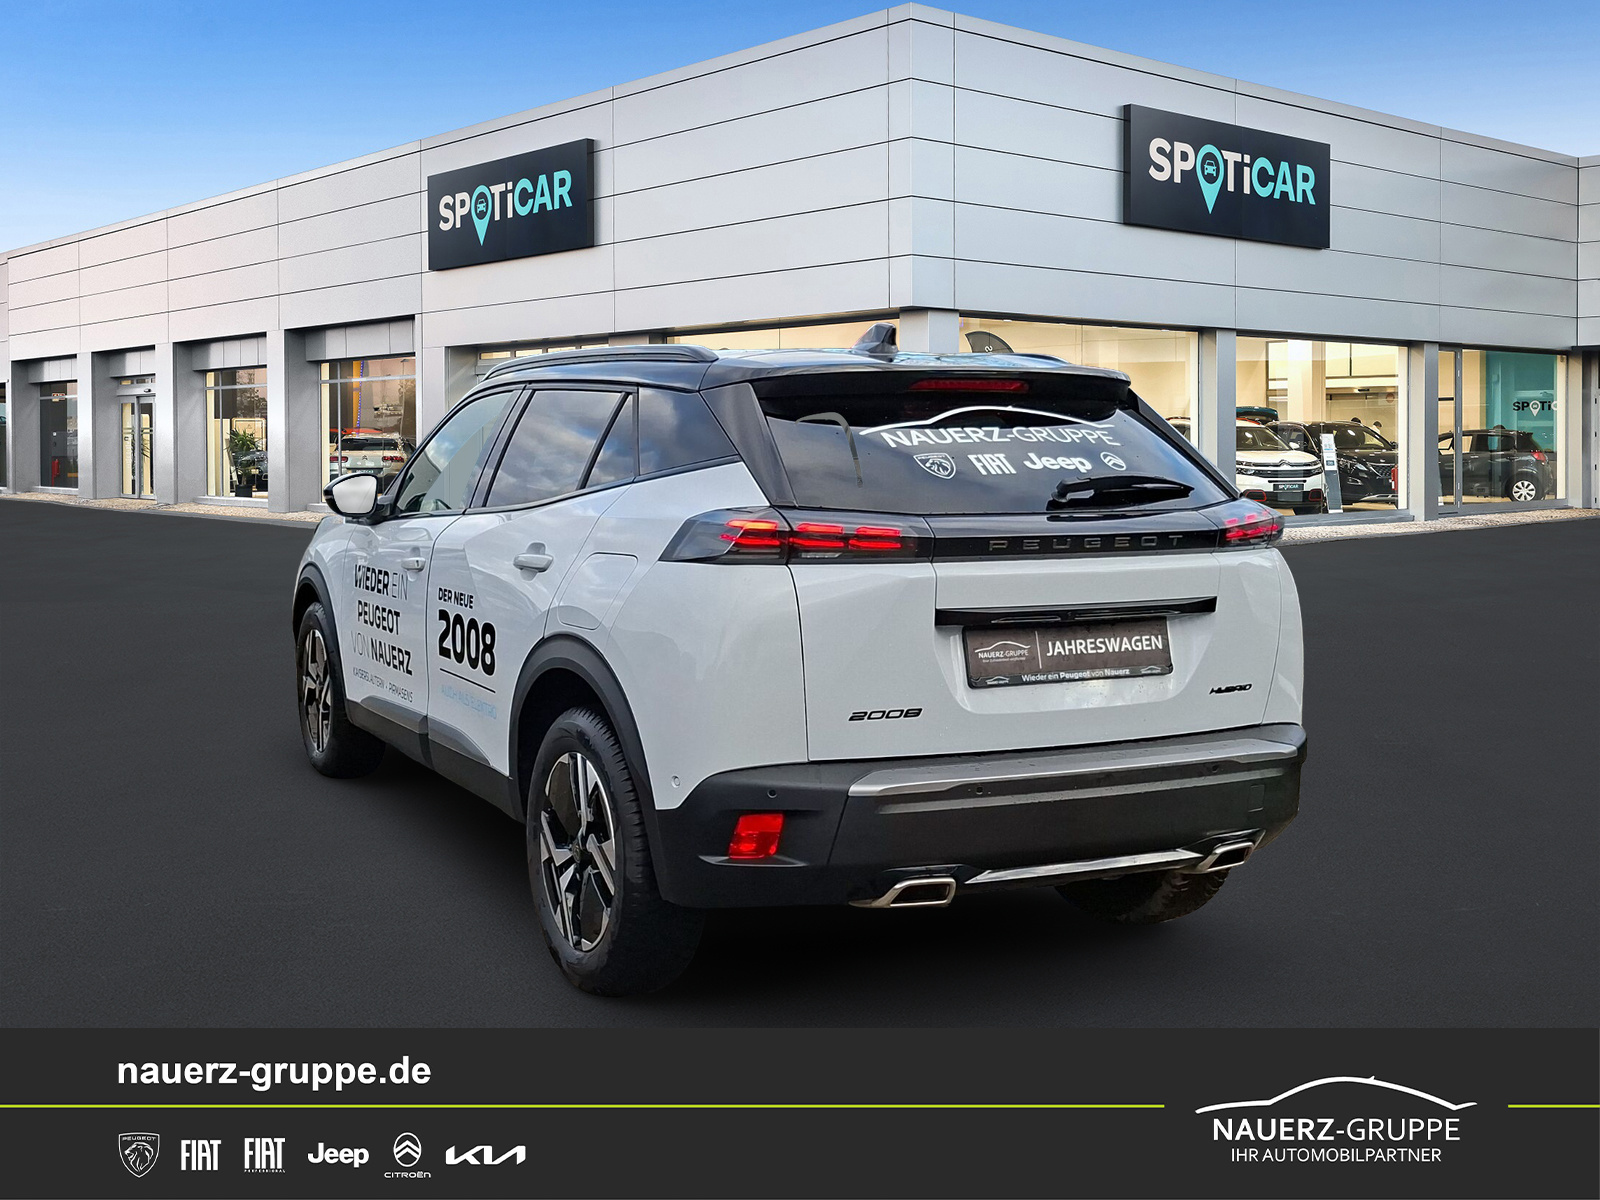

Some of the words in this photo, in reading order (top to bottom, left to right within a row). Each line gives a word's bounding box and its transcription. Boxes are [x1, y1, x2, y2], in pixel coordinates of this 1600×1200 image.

[880, 426, 1122, 448] NAUERZ-GRUPPE
[967, 453, 1017, 475] FIAT
[1023, 452, 1092, 474] Jeep
[989, 534, 1184, 551] PEUGEOT
[354, 564, 390, 597] WIEDER
[391, 571, 408, 601] EIN
[438, 587, 453, 604] DER
[453, 591, 474, 610] NEUE
[357, 599, 401, 636] PEUGEOT
[350, 630, 370, 658] VON
[370, 637, 413, 676] NAUERZ
[438, 608, 496, 677] 2008
[1046, 634, 1163, 657] JAHRESWAGEN
[978, 650, 1029, 659] NAUERZ-GRUPPE
[1021, 673, 1047, 682] Wieder
[1047, 672, 1059, 680] ein
[1059, 671, 1090, 680] Peugeot
[1104, 668, 1131, 677] Nauerz
[848, 707, 923, 721] 2008
